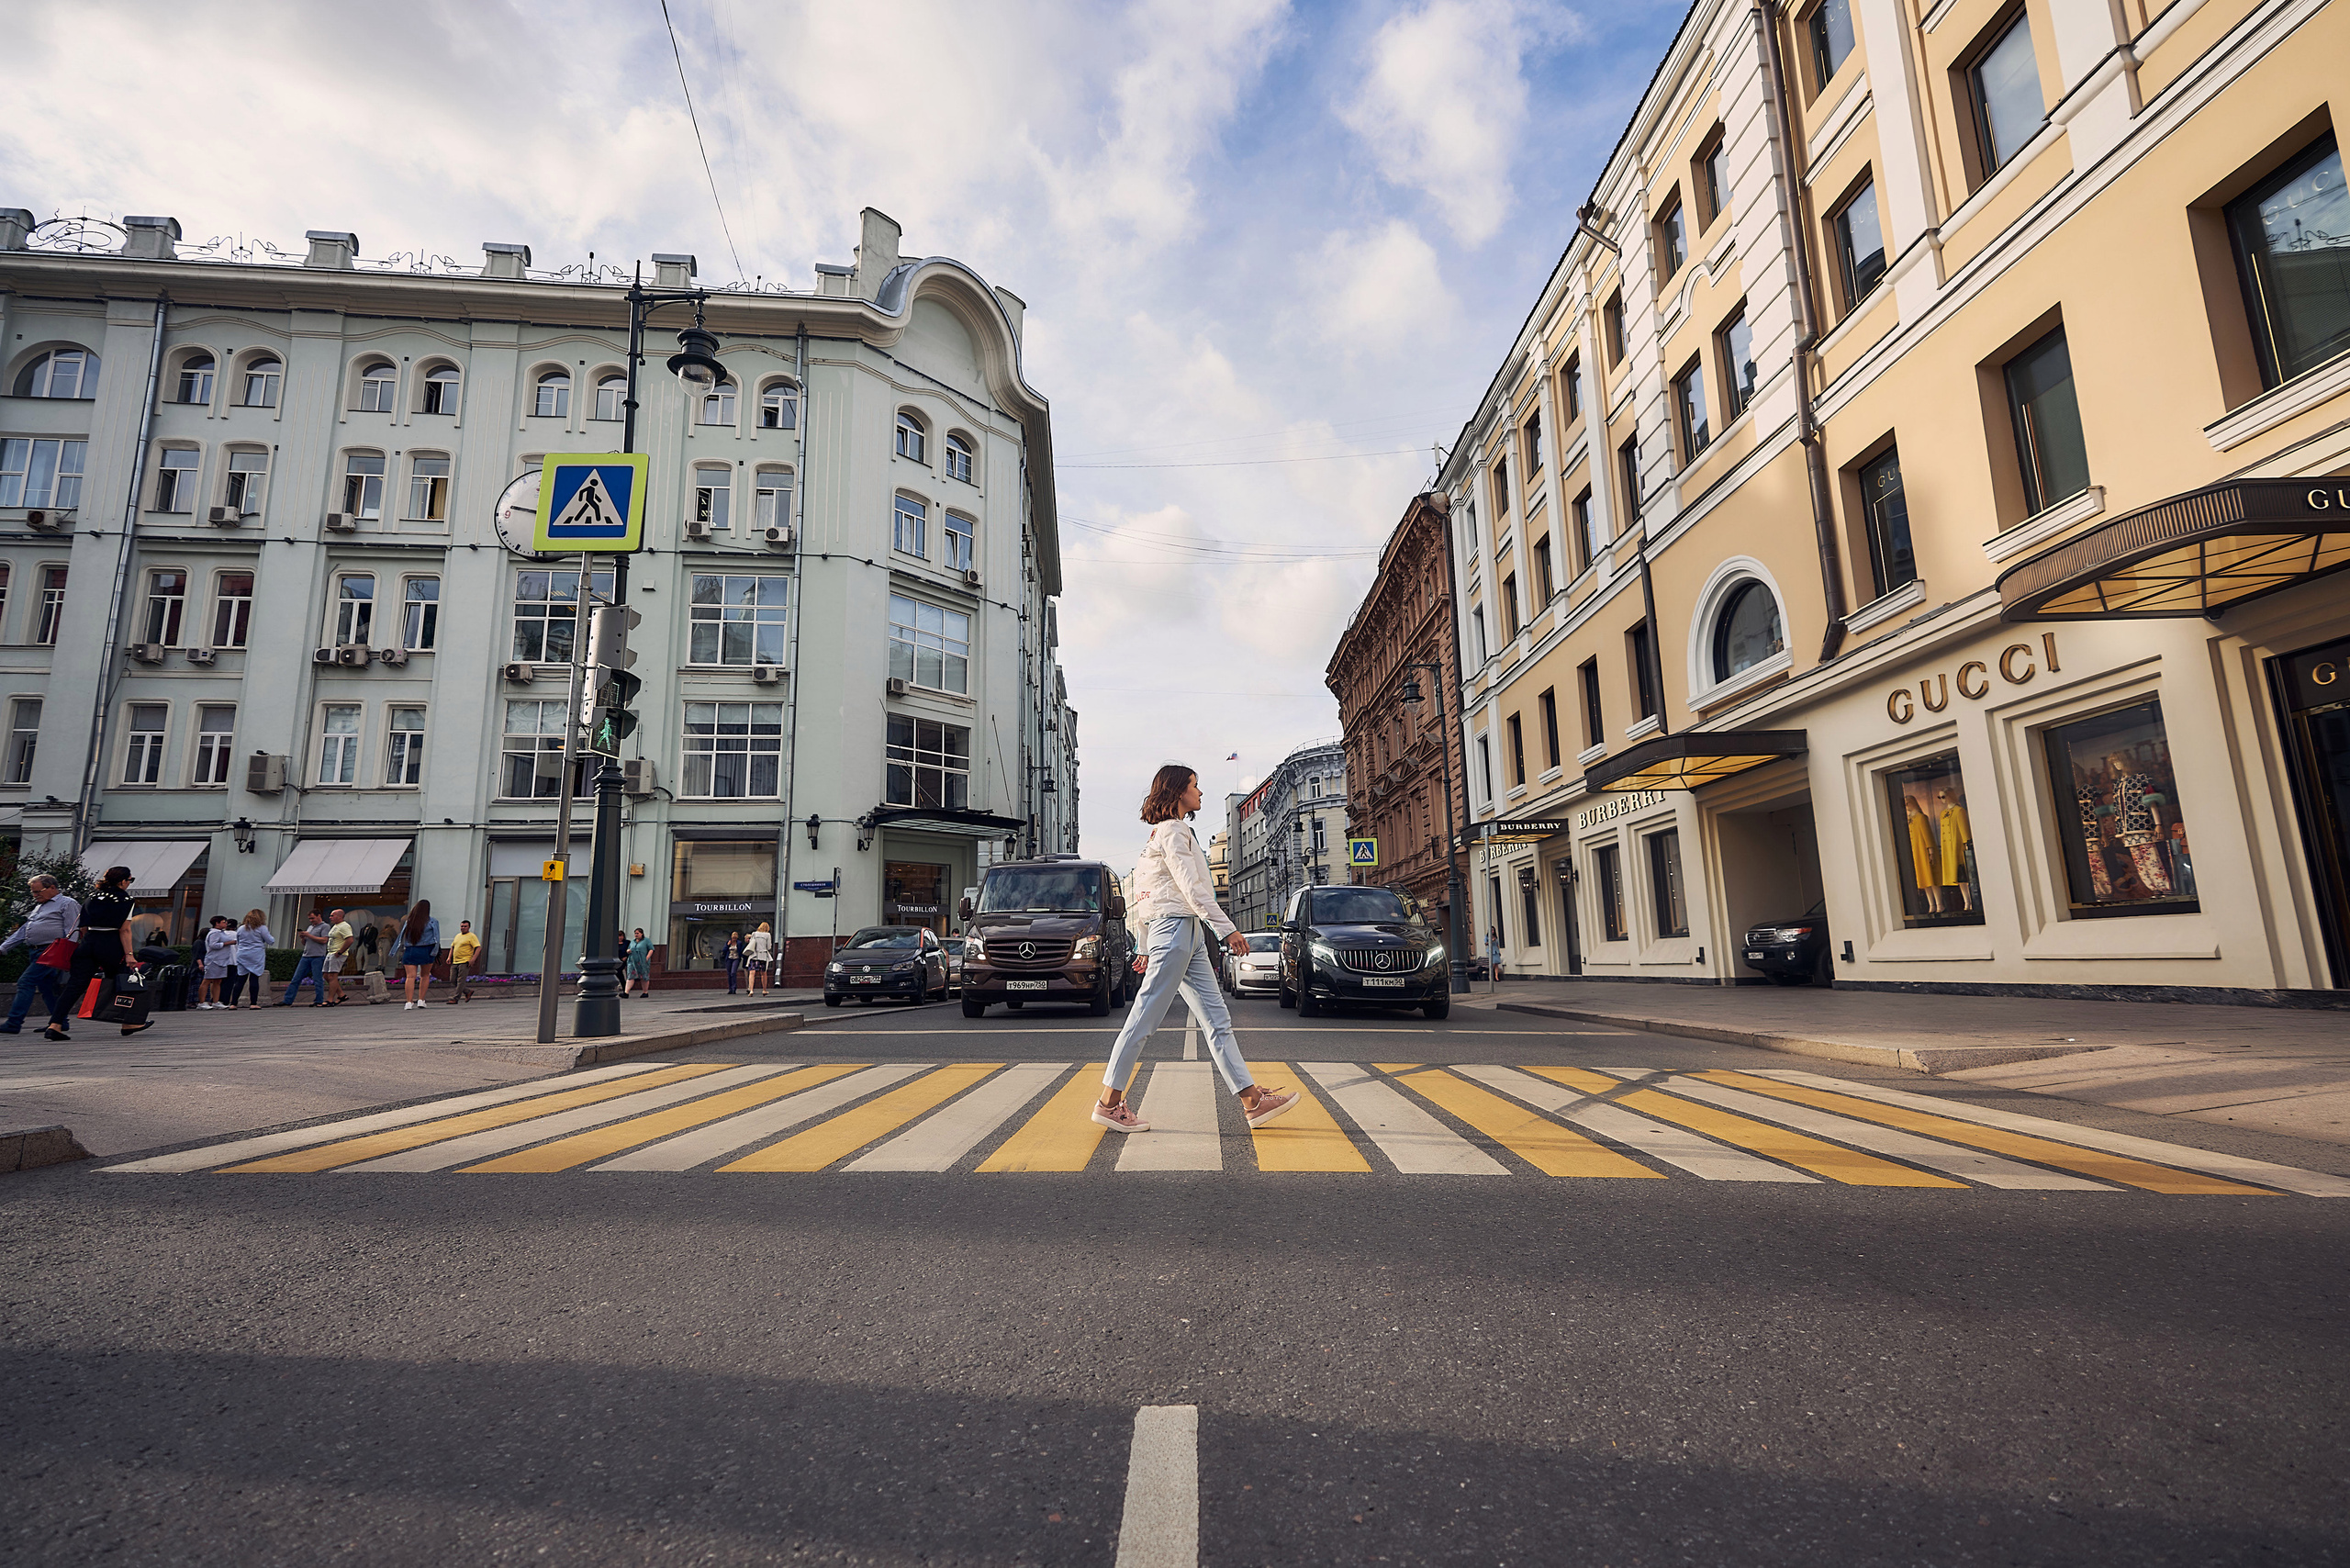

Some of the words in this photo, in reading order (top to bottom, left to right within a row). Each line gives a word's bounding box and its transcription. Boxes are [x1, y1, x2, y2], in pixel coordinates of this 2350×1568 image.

[1887, 633, 2061, 724] GUCCI
[1500, 822, 1561, 831] BURBERRY
[695, 903, 752, 912] TOURBILLON
[897, 904, 938, 913] TOURBILLON
